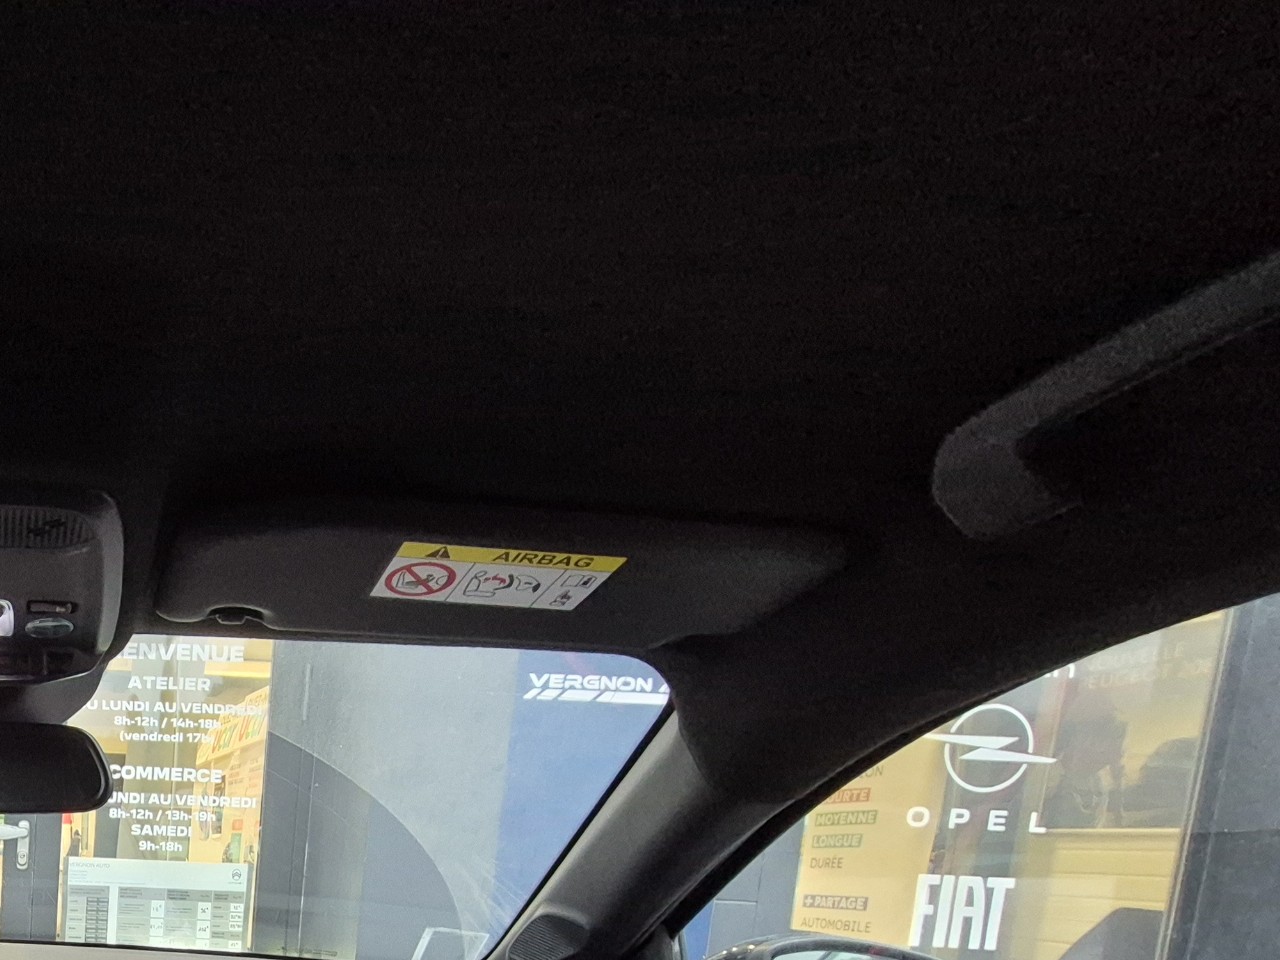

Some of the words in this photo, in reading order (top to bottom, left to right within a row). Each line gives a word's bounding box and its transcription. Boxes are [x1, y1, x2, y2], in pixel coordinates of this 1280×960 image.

[492, 550, 596, 569] AIRBAG
[118, 642, 246, 663] ENVENUE
[127, 675, 212, 692] ATELIER
[528, 672, 654, 692] VERGNON
[101, 700, 150, 712] LUNDI
[153, 701, 177, 713] AU
[180, 702, 263, 716] VENDREDI
[113, 715, 159, 728] 8h-12h
[170, 717, 222, 729] 14h-18h
[119, 730, 183, 743] (vendredi
[108, 764, 223, 783] COMMERCE
[107, 791, 145, 804] UNDI
[148, 792, 171, 806] AU
[175, 794, 257, 808] VENDREDI
[108, 807, 153, 820] 8h-12h
[165, 809, 217, 822] 13h-19h
[815, 810, 877, 826] MOYENNE
[906, 805, 1047, 834] OPEL
[130, 823, 193, 838] SAMEDI
[138, 840, 183, 852] 9h-18h
[812, 834, 862, 847] LONGUE
[809, 856, 844, 869] DURÉE
[909, 873, 1016, 952] FIAT
[800, 917, 872, 934] AUTOMOBILE
